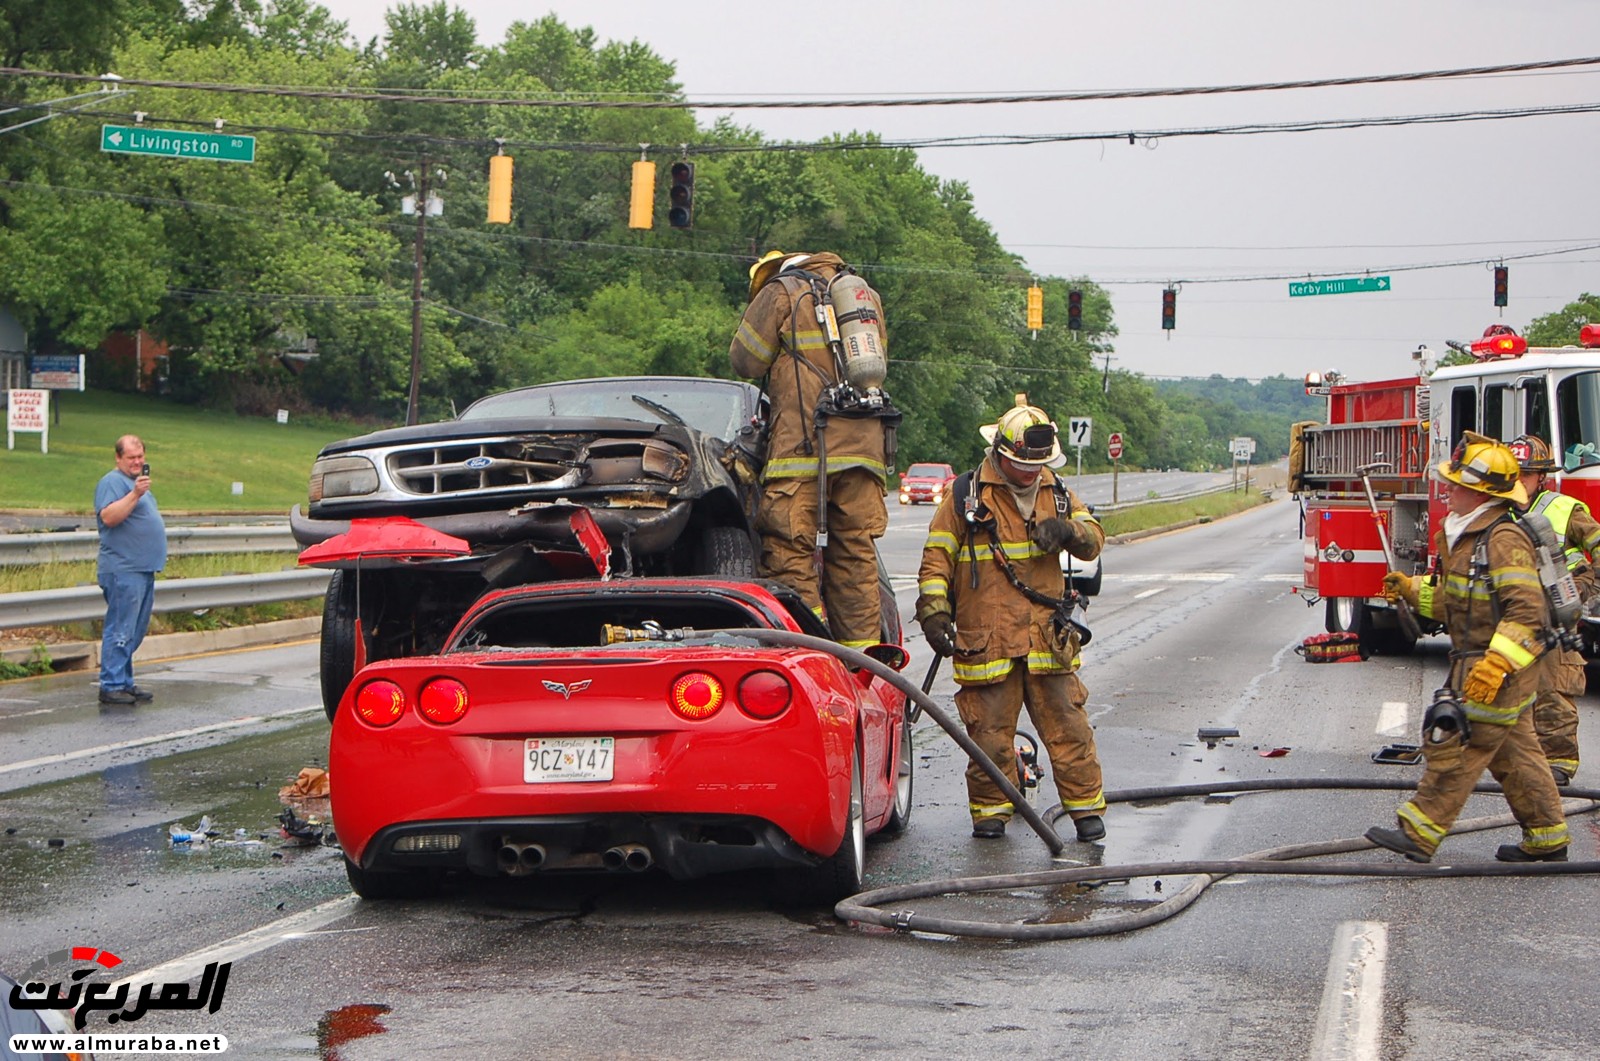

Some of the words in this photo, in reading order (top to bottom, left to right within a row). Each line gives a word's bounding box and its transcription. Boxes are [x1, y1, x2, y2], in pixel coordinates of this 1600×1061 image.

[129, 132, 220, 156] Livingston
[231, 139, 244, 148] RD
[1291, 284, 1321, 295] Kerby
[1326, 281, 1345, 292] Hill
[849, 336, 860, 356] SCOTT
[1510, 446, 1526, 459] 21
[551, 740, 586, 749] Maryland
[529, 749, 562, 771] 9CZ
[576, 748, 609, 769] Y47
